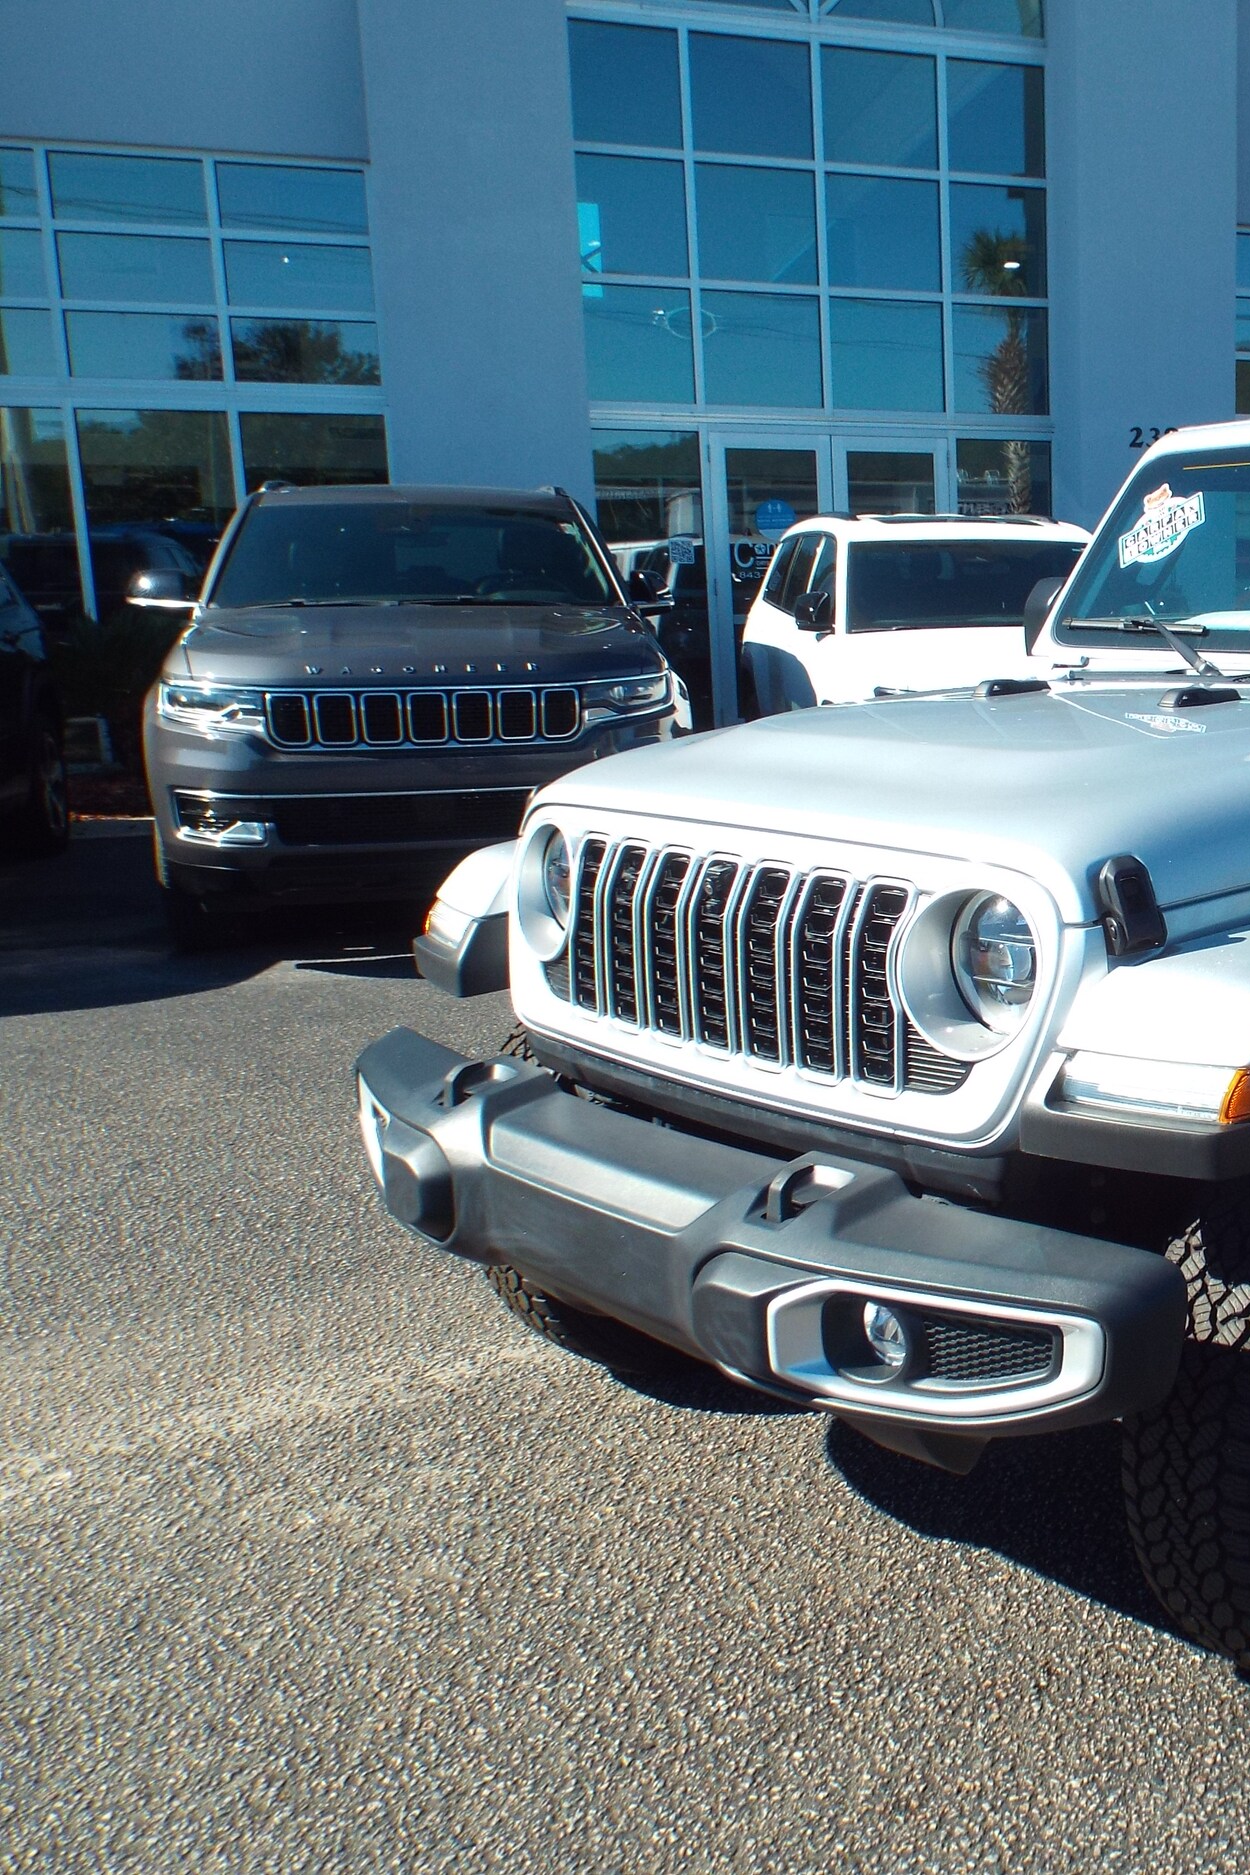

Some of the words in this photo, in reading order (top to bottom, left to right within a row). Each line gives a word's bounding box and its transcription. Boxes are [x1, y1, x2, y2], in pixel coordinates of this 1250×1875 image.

[1129, 427, 1178, 448] 23
[1124, 502, 1198, 549] CARFAX
[304, 661, 539, 675] WAGONEER
